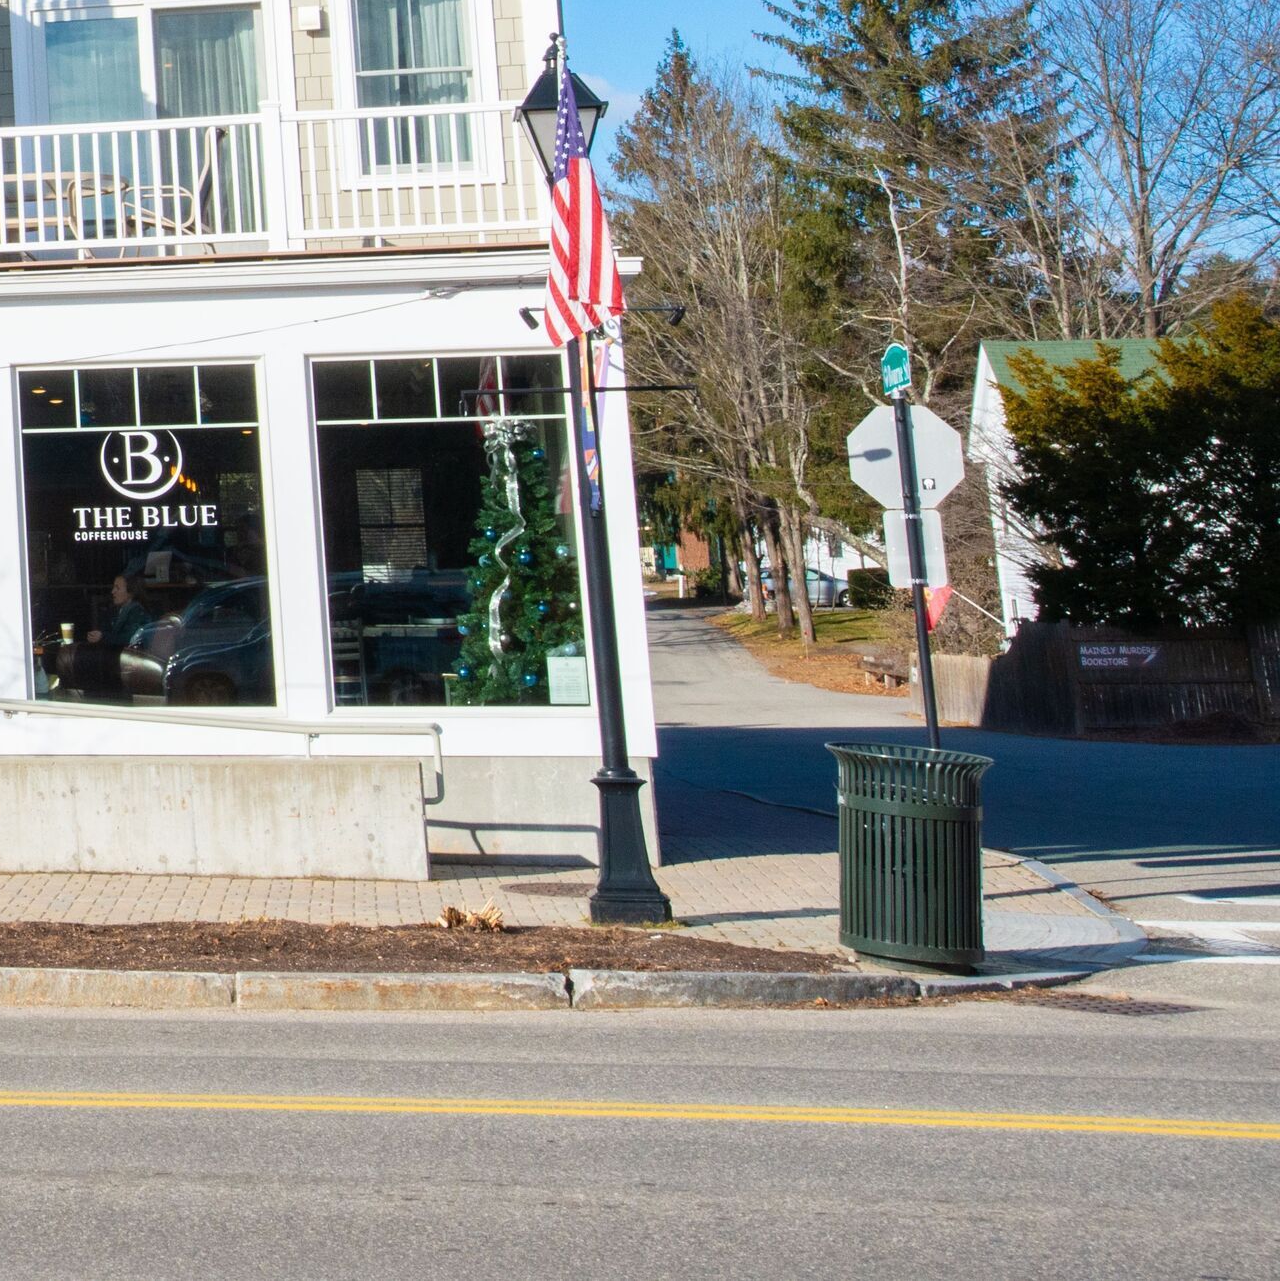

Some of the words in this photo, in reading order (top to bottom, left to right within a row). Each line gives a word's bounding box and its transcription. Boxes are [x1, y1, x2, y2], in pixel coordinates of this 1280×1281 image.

[119, 431, 163, 485] B
[73, 507, 133, 529] THE
[142, 505, 218, 527] BLUE
[74, 530, 149, 541] COFFEEHOUSE
[1081, 656, 1129, 666] BOOKSTORE
